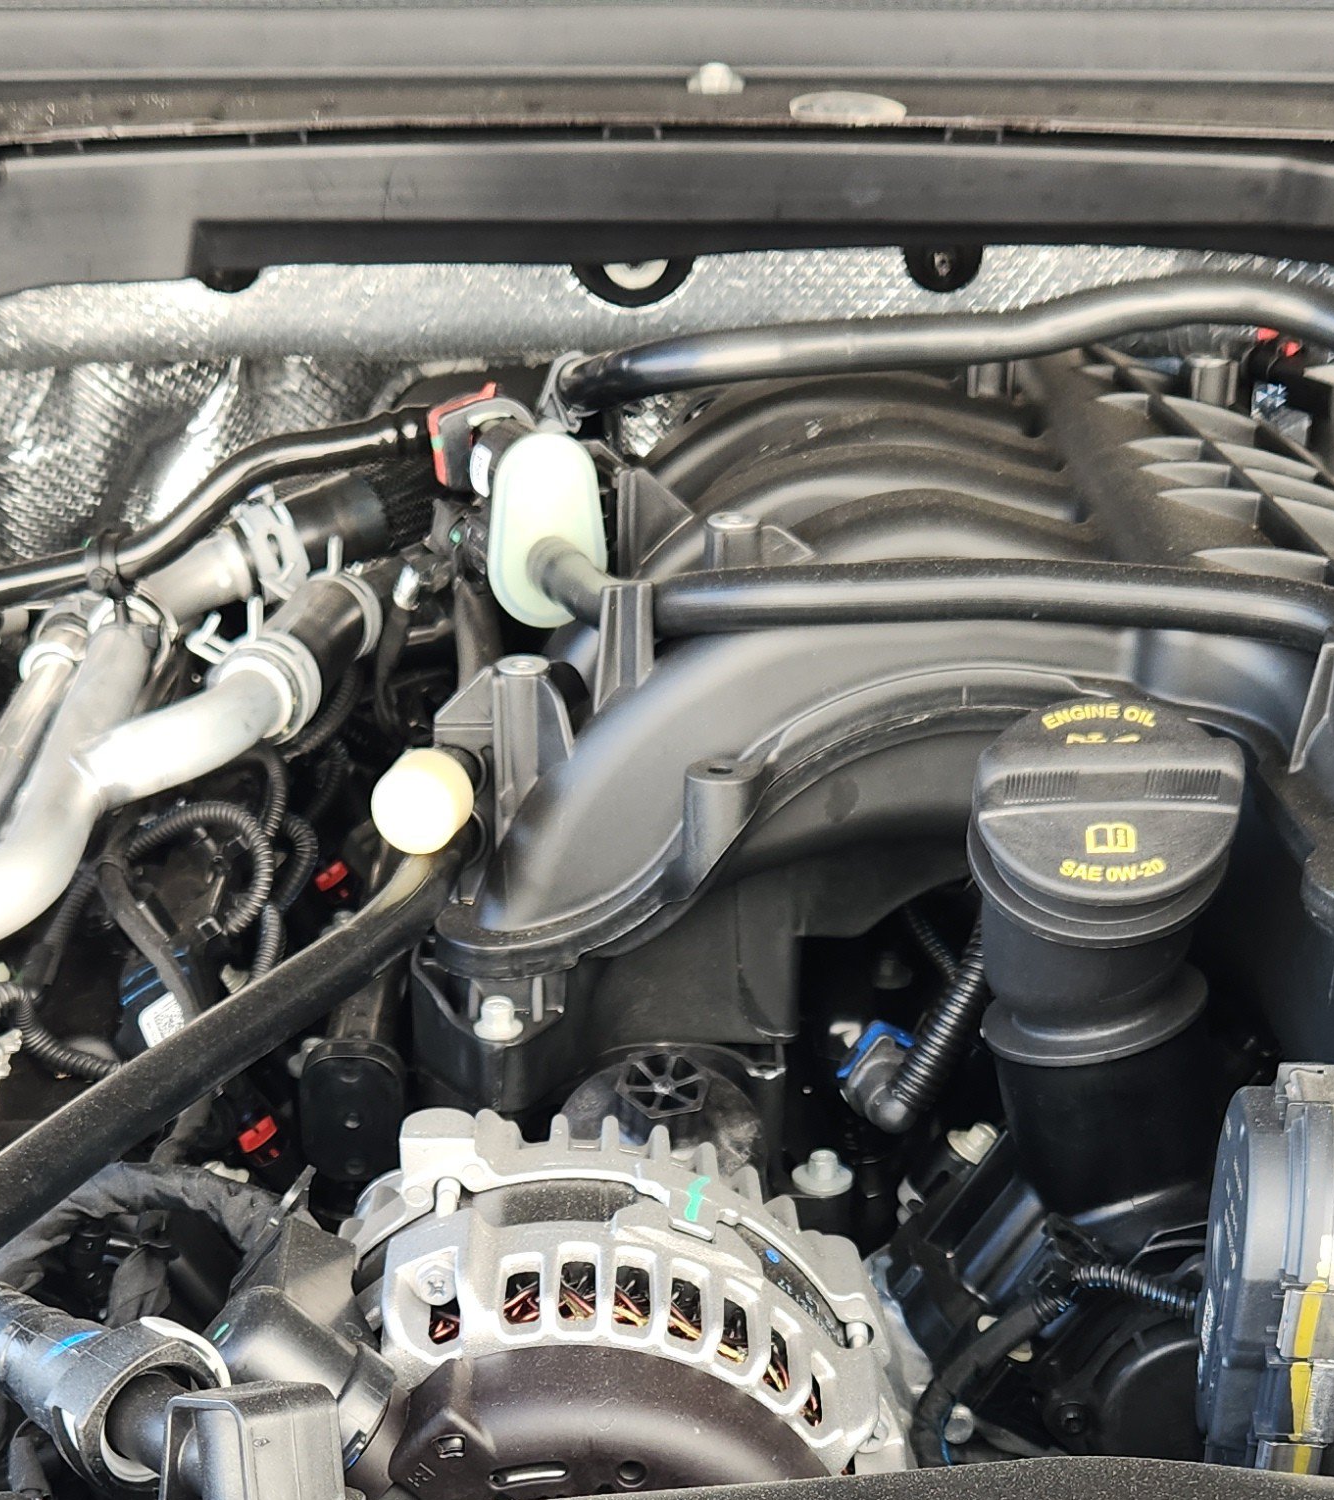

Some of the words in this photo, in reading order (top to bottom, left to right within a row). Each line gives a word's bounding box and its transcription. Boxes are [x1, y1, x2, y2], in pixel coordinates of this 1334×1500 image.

[1041, 703, 1119, 731] ENGINE
[1123, 706, 1157, 728] OIL
[1059, 859, 1102, 882] SAE
[1105, 858, 1167, 883] 0W-20
